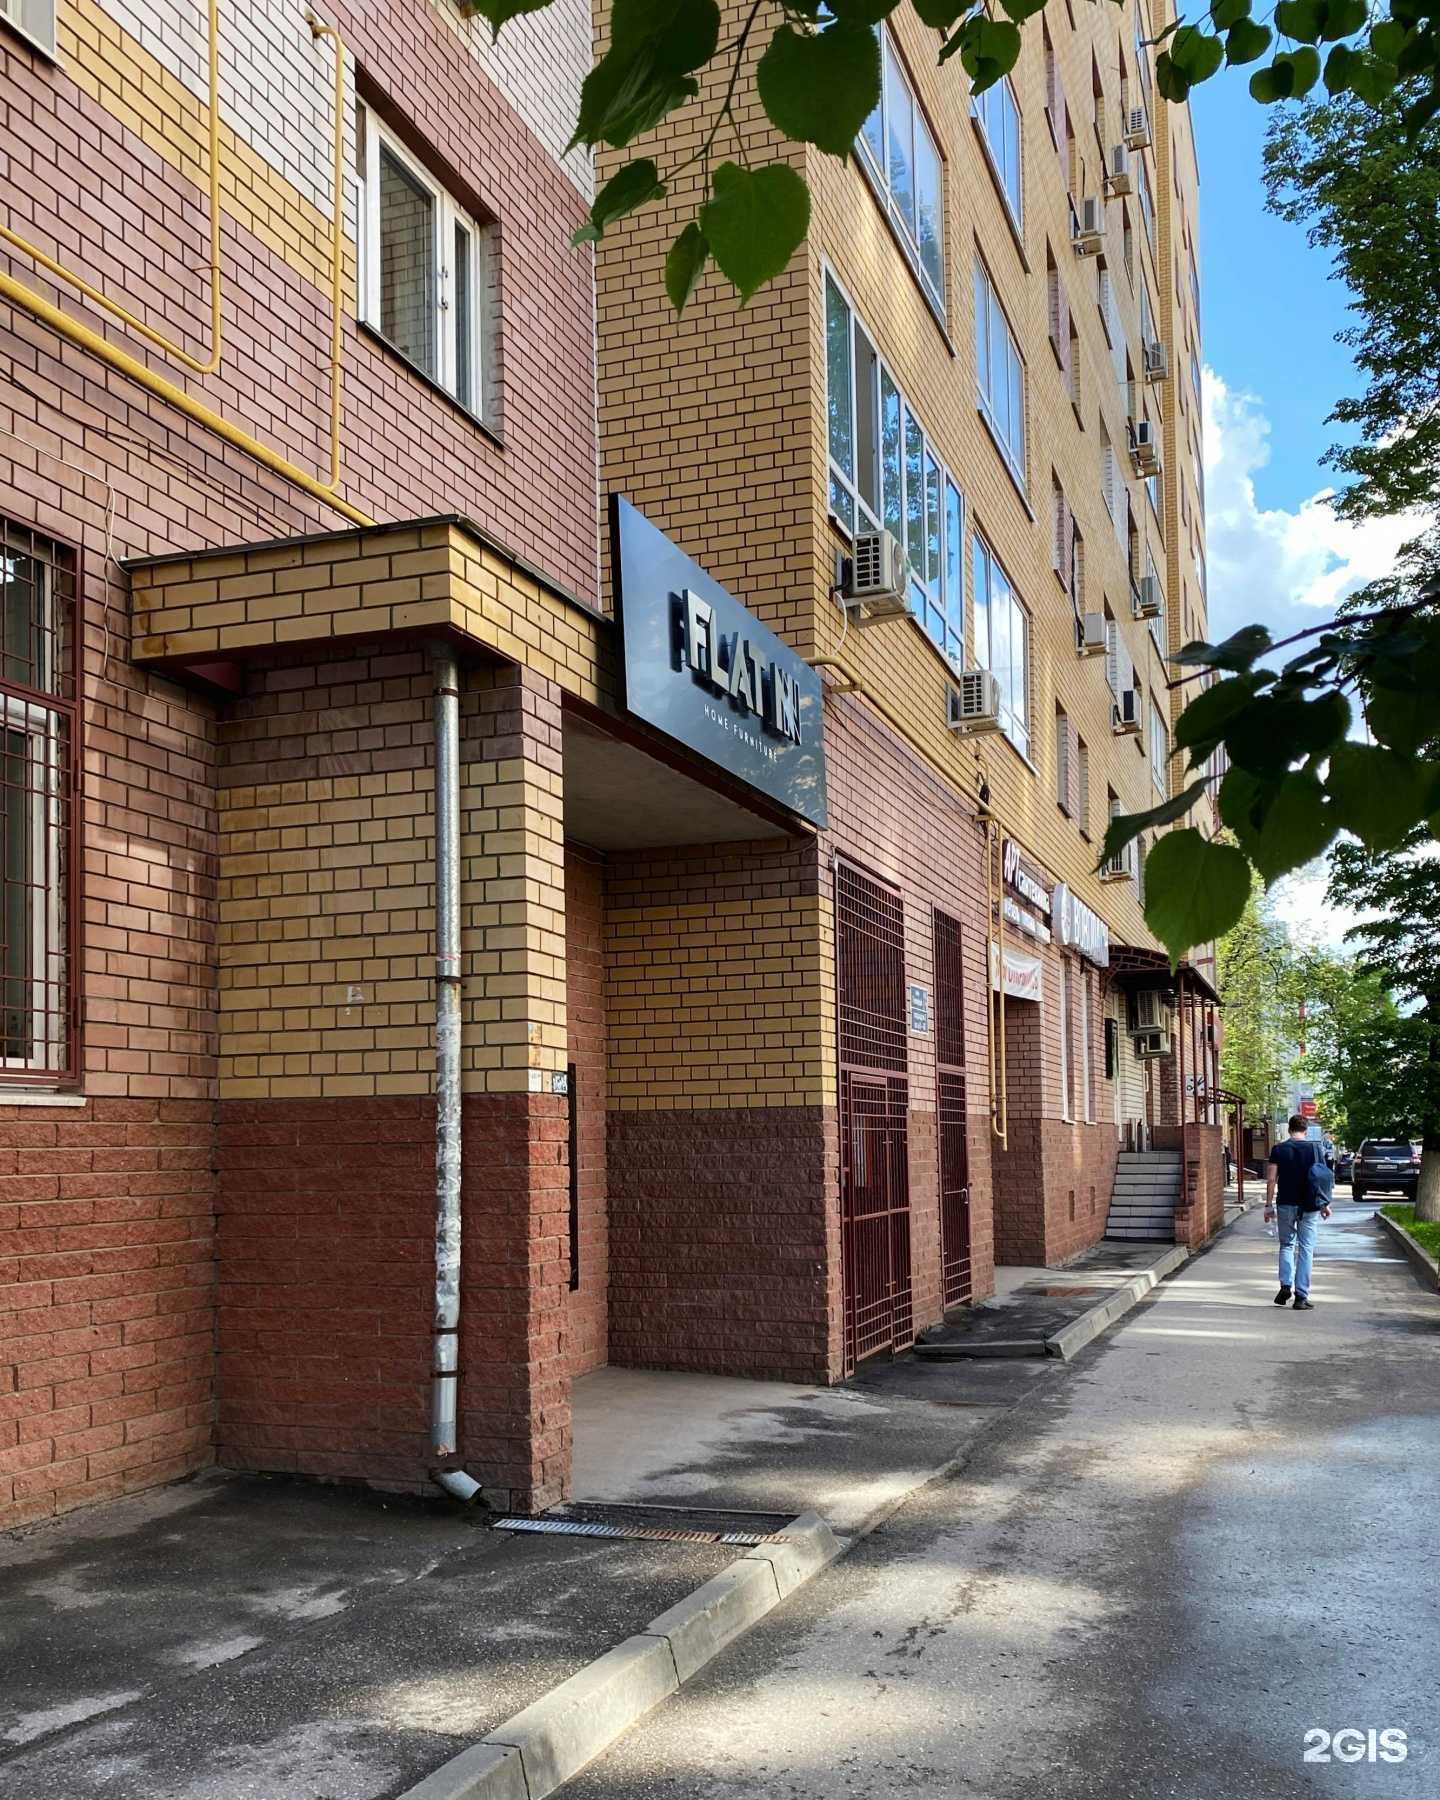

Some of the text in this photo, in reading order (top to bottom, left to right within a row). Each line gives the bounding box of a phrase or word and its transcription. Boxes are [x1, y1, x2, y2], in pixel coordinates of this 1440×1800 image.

[682, 588, 766, 718] FLAT
[704, 703, 778, 762] HOME FURNITURE
